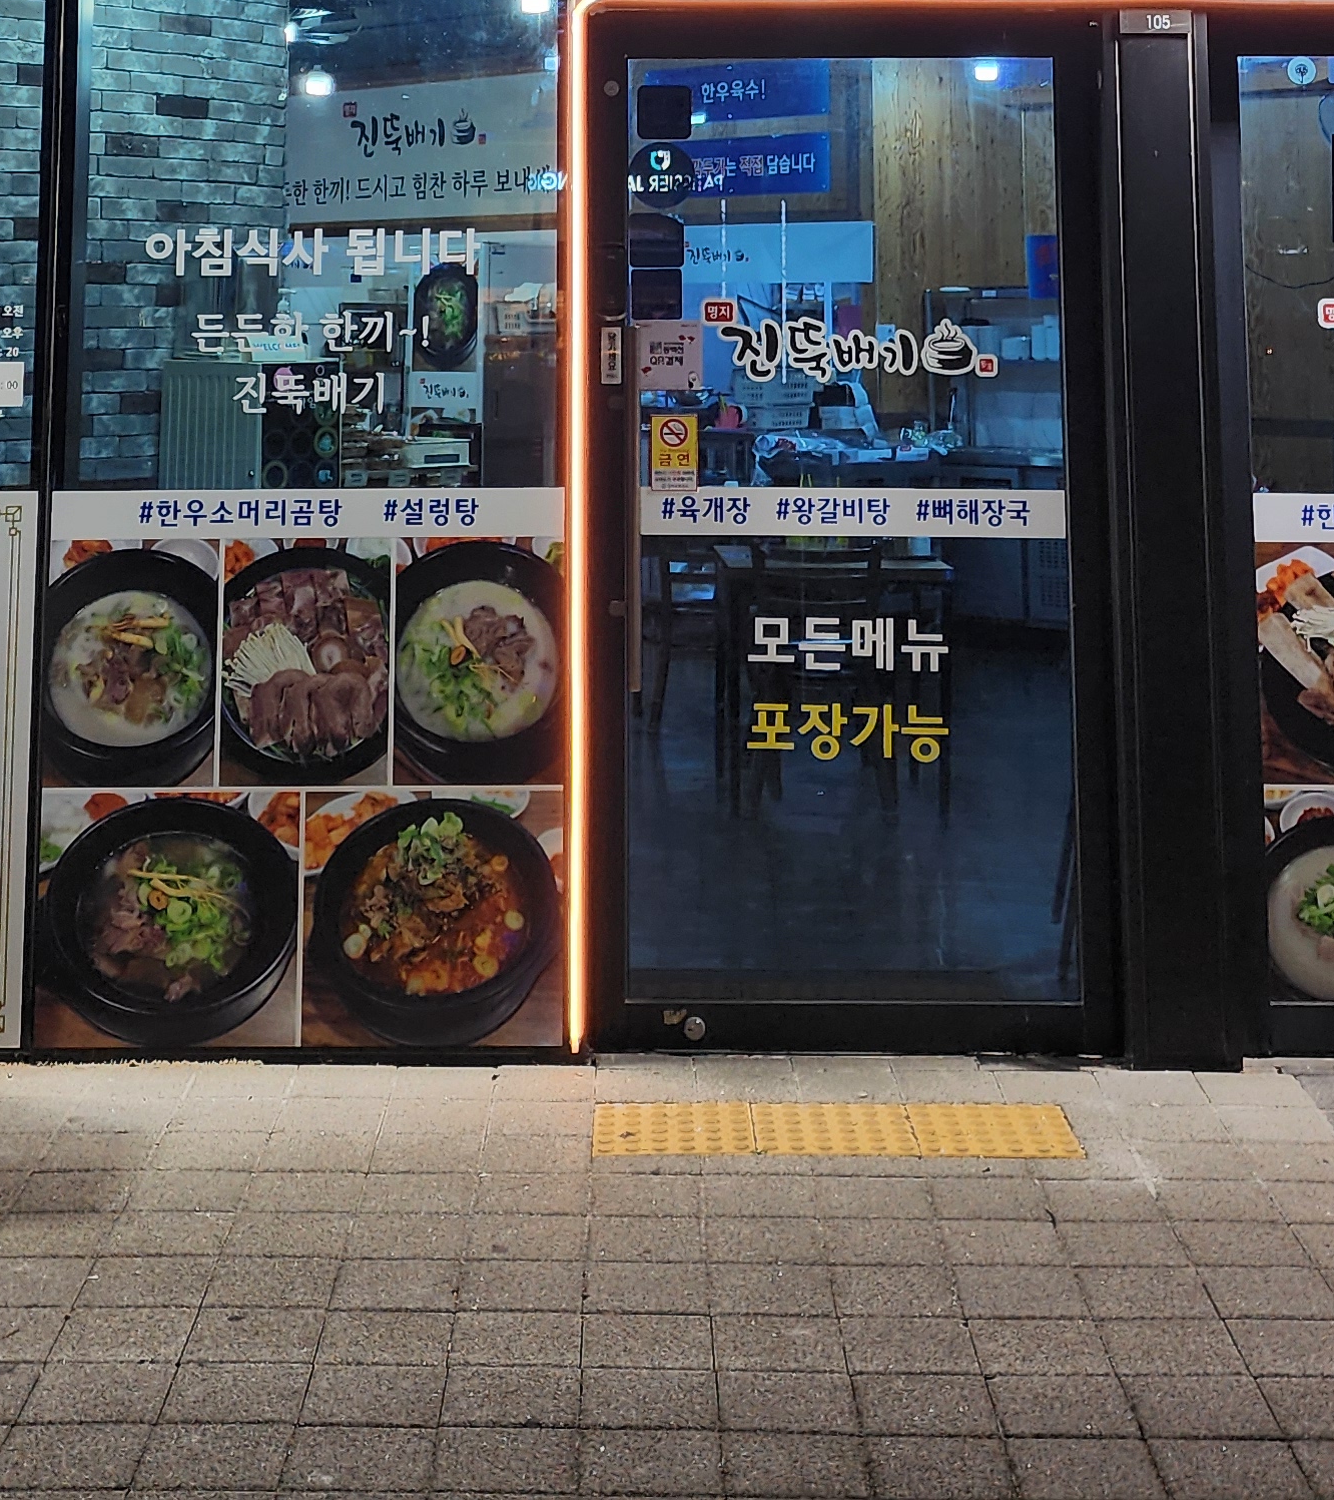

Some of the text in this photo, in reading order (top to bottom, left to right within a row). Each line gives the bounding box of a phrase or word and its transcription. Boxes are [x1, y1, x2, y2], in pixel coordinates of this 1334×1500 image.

[1146, 14, 1171, 30] 105
[701, 78, 766, 104] 한우육수!
[350, 112, 445, 158] 진뚝배기
[767, 152, 816, 175] 담습니다
[313, 176, 350, 205] 한끼!
[356, 173, 407, 202] 드시고
[412, 171, 447, 200] 힘찬
[452, 168, 489, 197] 하루
[145, 227, 482, 277] 아침식사 됩니다
[2, 304, 24, 318] 오전
[707, 305, 731, 319] 명지
[0, 326, 24, 340] 오후
[191, 311, 310, 353] 든든한
[721, 319, 919, 380] 진뚝배기
[233, 371, 386, 416] 진뚝배기
[658, 453, 691, 467] 금연
[138, 497, 481, 528] #한우소머리곰탕 #설렁탕
[660, 495, 1031, 528] #육개장 #왕갈비탕 #뼈해장국
[747, 616, 949, 672] 모든메뉴
[746, 703, 950, 763] 포장가능
